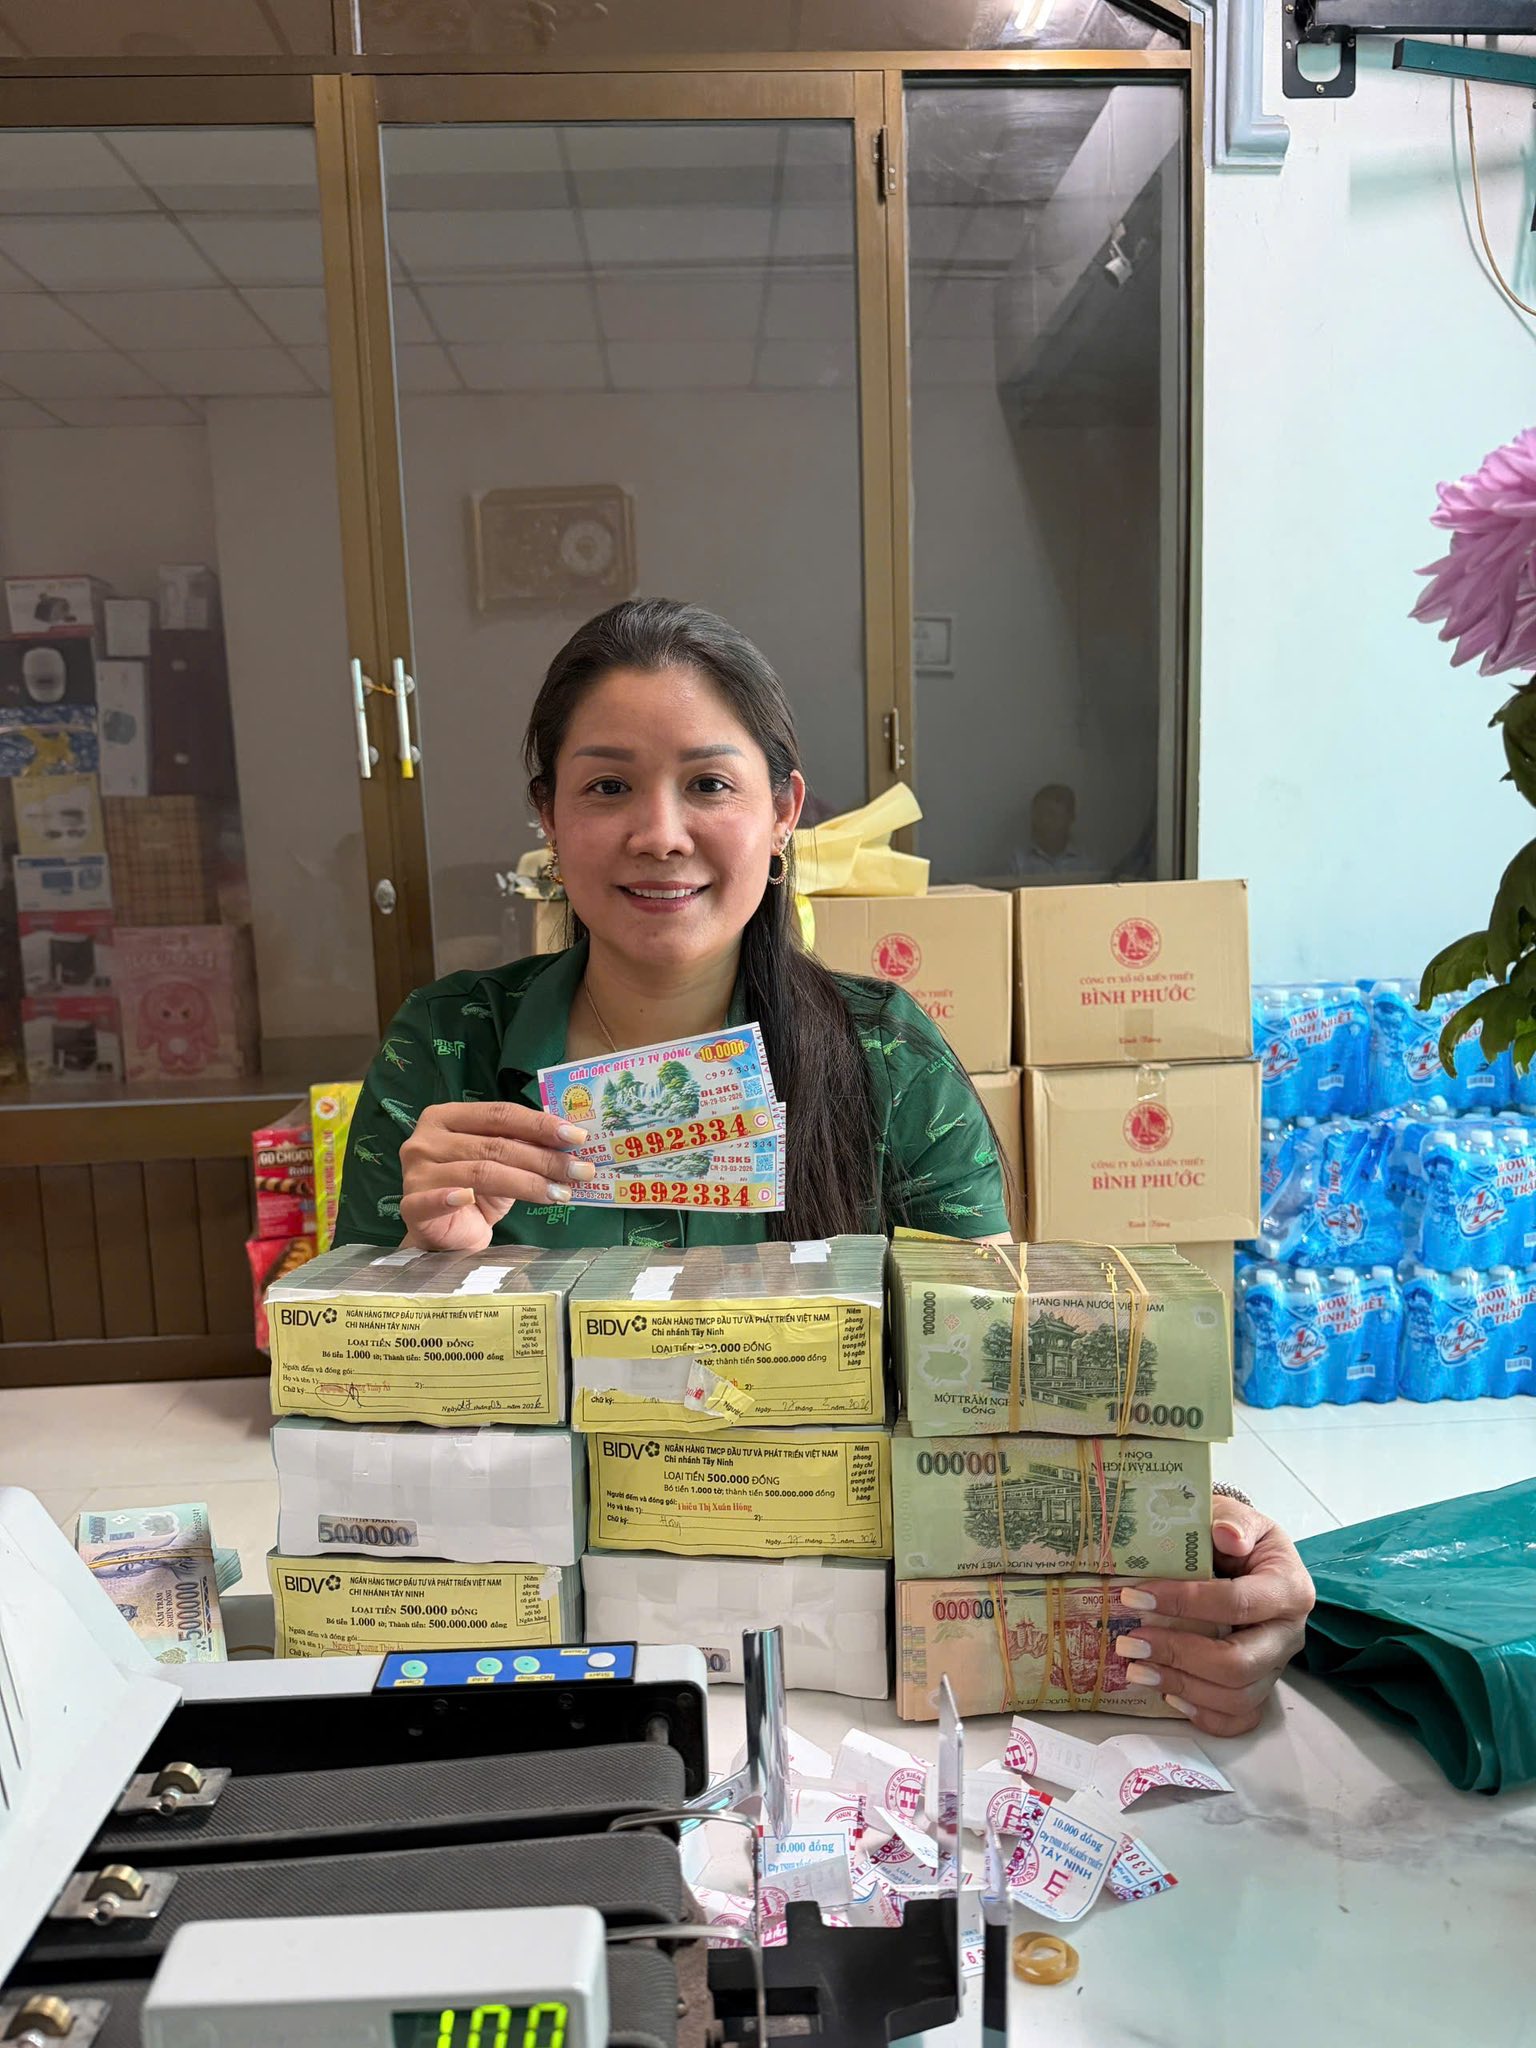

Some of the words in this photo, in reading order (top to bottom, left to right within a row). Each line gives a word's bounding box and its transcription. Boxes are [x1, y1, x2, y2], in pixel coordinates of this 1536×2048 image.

[1081, 987, 1126, 1006] BÌNH
[1131, 983, 1196, 1004] PHƯỚC
[639, 1057, 645, 1067] 2
[662, 1047, 692, 1061] ĐỒNG
[755, 1114, 768, 1127] C
[624, 1114, 749, 1159] 992334
[1092, 1172, 1136, 1190] BÌNH
[1141, 1168, 1206, 1188] PHƯỚC
[629, 1181, 750, 1207] 992334
[760, 1190, 771, 1200] D
[1032, 1296, 1061, 1307] HÀNG
[1063, 1297, 1085, 1309] NHÀ
[281, 1308, 323, 1327] BIDV
[382, 1311, 400, 1319] TMCP
[483, 1310, 499, 1318] NAM
[651, 1316, 672, 1325] NGÂN
[673, 1316, 694, 1326] HÀNG
[695, 1317, 715, 1325] TMCP
[813, 1313, 831, 1322] NAM
[345, 1320, 358, 1329] CHI
[359, 1320, 386, 1330] NHÁNH
[387, 1321, 400, 1330] TÂY
[401, 1322, 421, 1331] NINH
[586, 1318, 631, 1336] BIDV
[651, 1328, 664, 1337] Chi
[666, 1328, 690, 1336] nhánh
[706, 1327, 725, 1337] Ninh
[347, 1338, 369, 1348] LOẠI
[370, 1337, 391, 1348] TIỀN
[394, 1337, 443, 1348] 500.000
[446, 1337, 475, 1348] ĐỒNG
[651, 1344, 673, 1355] LOẠI
[743, 1340, 772, 1352] ĐỒNG
[346, 1349, 371, 1359] 1.000
[424, 1351, 484, 1362] 500.000.000
[756, 1355, 806, 1364] 500.000.000
[958, 1392, 988, 1406] TRĂM
[962, 1399, 996, 1416] ĐỒNG
[603, 1441, 645, 1461] BIDV
[664, 1443, 684, 1453] NGÂN
[685, 1444, 705, 1454] HÀNG
[707, 1446, 726, 1455] TMCP
[764, 1448, 783, 1458] PHÁT
[805, 1449, 820, 1460] VIỆT
[822, 1449, 839, 1458] NAM
[664, 1455, 677, 1464] Chi
[678, 1455, 701, 1465] nhánh
[702, 1456, 715, 1467] Tây
[716, 1457, 734, 1467] Ninh
[663, 1471, 684, 1482] LOẠI
[684, 1470, 705, 1482] TIỀN
[707, 1472, 750, 1484] 500.000
[751, 1474, 780, 1486] ĐỒNG
[663, 1484, 674, 1492] Bó
[675, 1484, 689, 1493] tiền
[691, 1486, 713, 1495] 1.000
[725, 1488, 748, 1497] thành
[748, 1488, 763, 1497] tiền
[765, 1489, 814, 1498] 500.000.000
[815, 1489, 836, 1499] đồng
[285, 1575, 327, 1595] BIDV
[385, 1578, 402, 1587] TMCP
[487, 1579, 502, 1587] NAM
[349, 1588, 362, 1597] CHI
[362, 1588, 390, 1598] NHÁNH
[390, 1588, 404, 1598] TÂY
[405, 1590, 425, 1598] NINH
[351, 1606, 373, 1615] LOẠI
[375, 1604, 397, 1615] TIỀN
[400, 1604, 448, 1616] 500.000
[451, 1605, 478, 1616] ĐỒNG
[350, 1617, 376, 1627] 1.000
[428, 1619, 488, 1629] 500.000.000
[1052, 1817, 1079, 1838] 10.000
[1079, 1828, 1104, 1853] đồng
[775, 1842, 806, 1854] 10.000
[808, 1841, 835, 1854] đồng
[1040, 1844, 1061, 1863] TÂY
[1063, 1859, 1093, 1881] NINH
